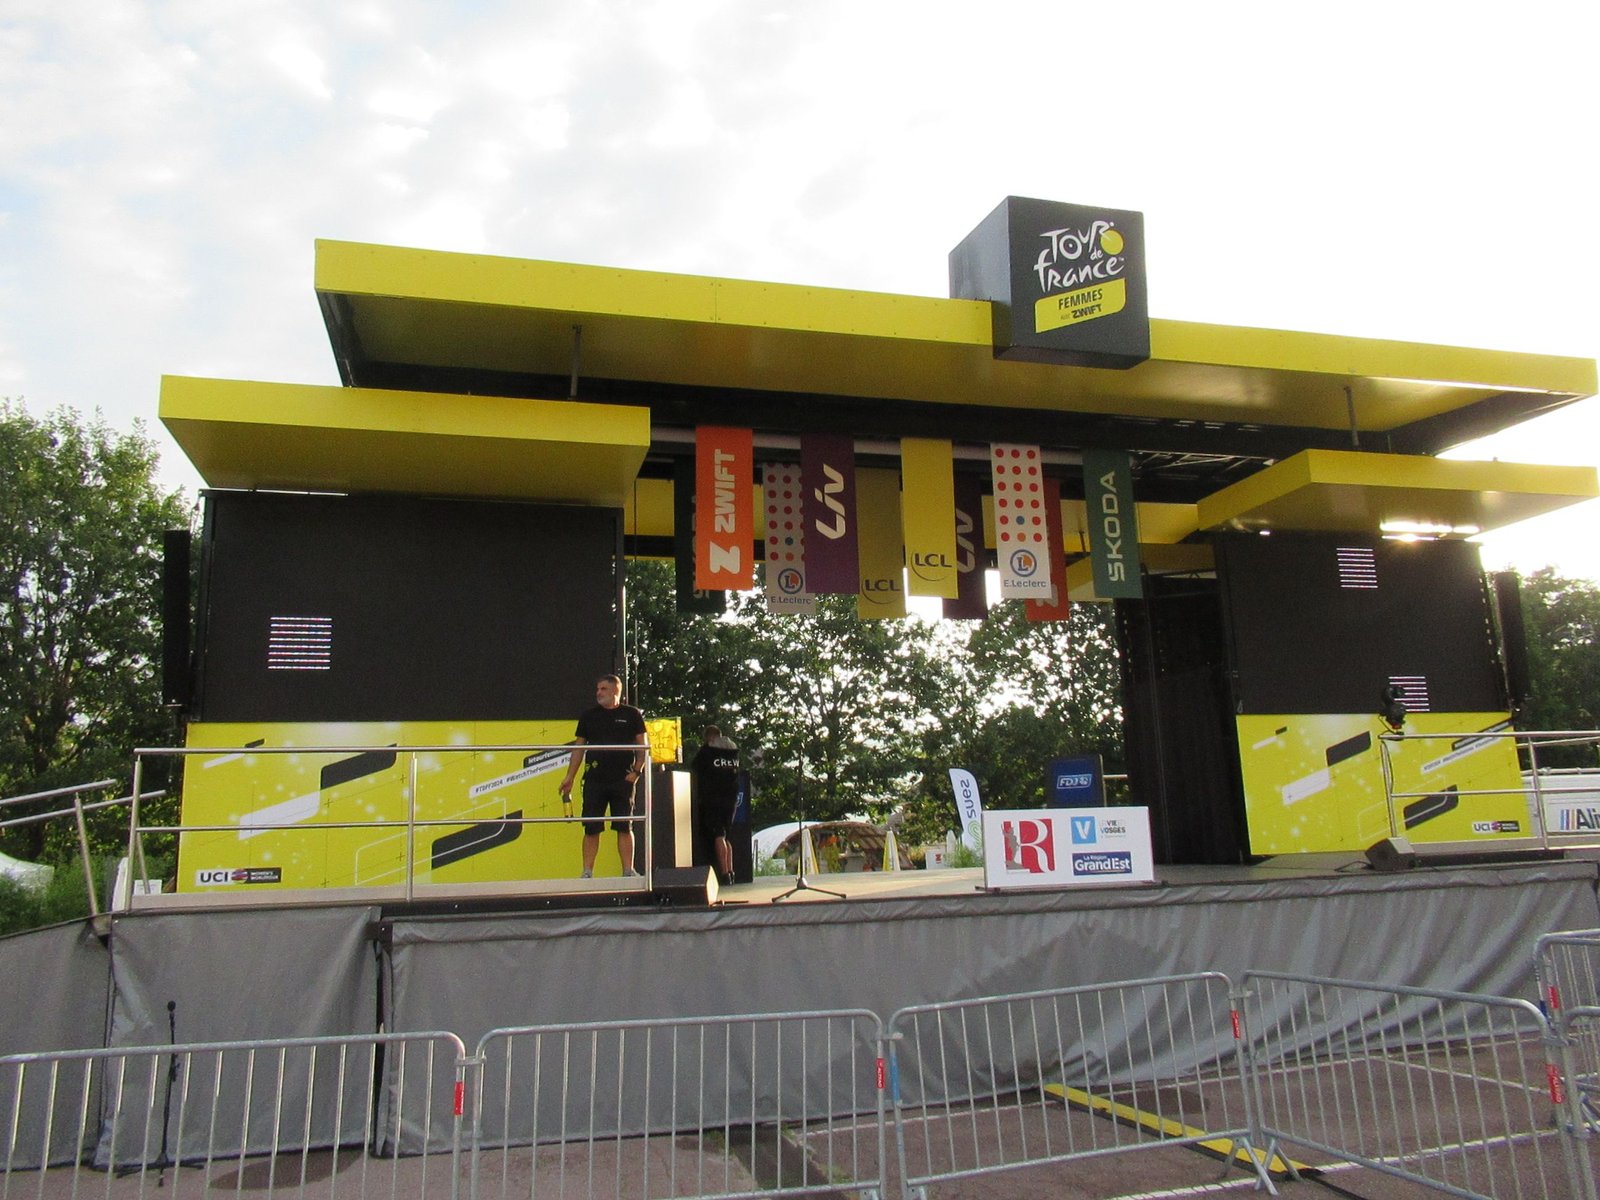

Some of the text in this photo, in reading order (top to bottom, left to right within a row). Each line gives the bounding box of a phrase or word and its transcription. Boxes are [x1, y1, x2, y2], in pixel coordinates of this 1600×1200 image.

[1090, 247, 1103, 261] de
[1058, 288, 1103, 310] FEMMES
[1071, 303, 1102, 319] ZWIFT
[714, 448, 736, 534] ZWIFT
[914, 553, 953, 568] LCL
[864, 579, 900, 592] LCL
[1003, 579, 1047, 589] E.Leclerc
[770, 596, 811, 605] E.Leclerc
[713, 758, 740, 768] CREW
[1060, 777, 1079, 786] FDJ
[1473, 823, 1491, 832] UCI
[200, 871, 229, 883] UCI
